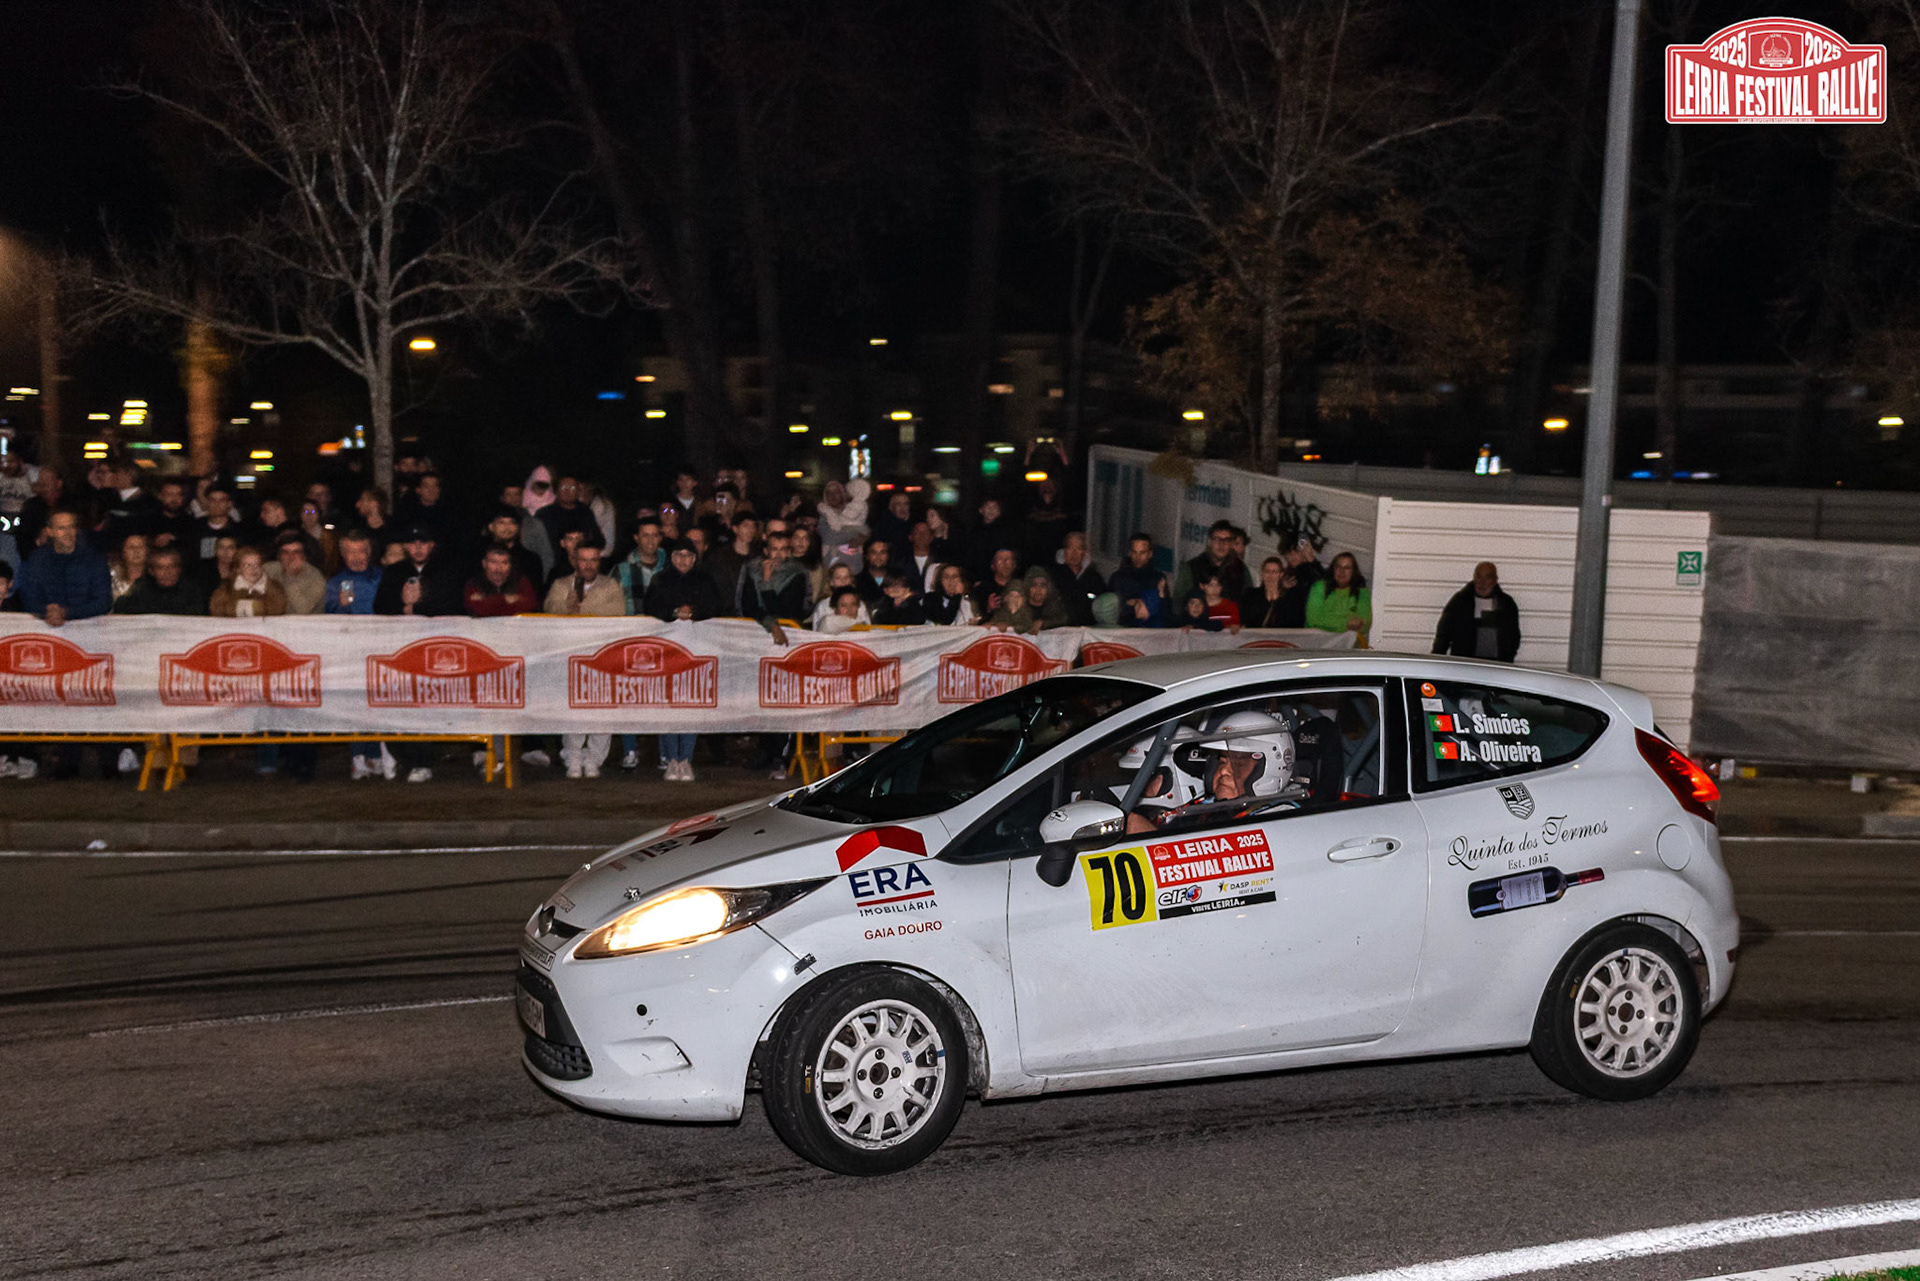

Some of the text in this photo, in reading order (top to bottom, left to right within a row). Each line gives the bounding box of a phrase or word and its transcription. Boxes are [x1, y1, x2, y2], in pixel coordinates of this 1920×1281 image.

[372, 660, 520, 704] LEIRIA FESTIVAL RALLYE
[574, 661, 713, 704] LEIRIA FESTIVAL RALLYE
[764, 662, 896, 704] LEIRIA FESTIVAL RALLYE
[942, 658, 977, 699] LEIRIA
[1453, 713, 1531, 735] L. Simões
[1460, 740, 1542, 763] A. Oliveira
[1174, 833, 1265, 859] LEIRIA 2025
[1447, 815, 1609, 871] Quinta dos Termos
[1158, 851, 1271, 884] FESTIVAL RALLYE
[1507, 852, 1550, 870] Est. 1945
[848, 862, 932, 899] ERA
[1088, 852, 1146, 924] 70
[1230, 877, 1270, 890] DASP RENT
[859, 899, 938, 918] IMOBILIÁRIA
[1158, 887, 1188, 907] elf
[864, 920, 943, 941] GAIA DOURO
